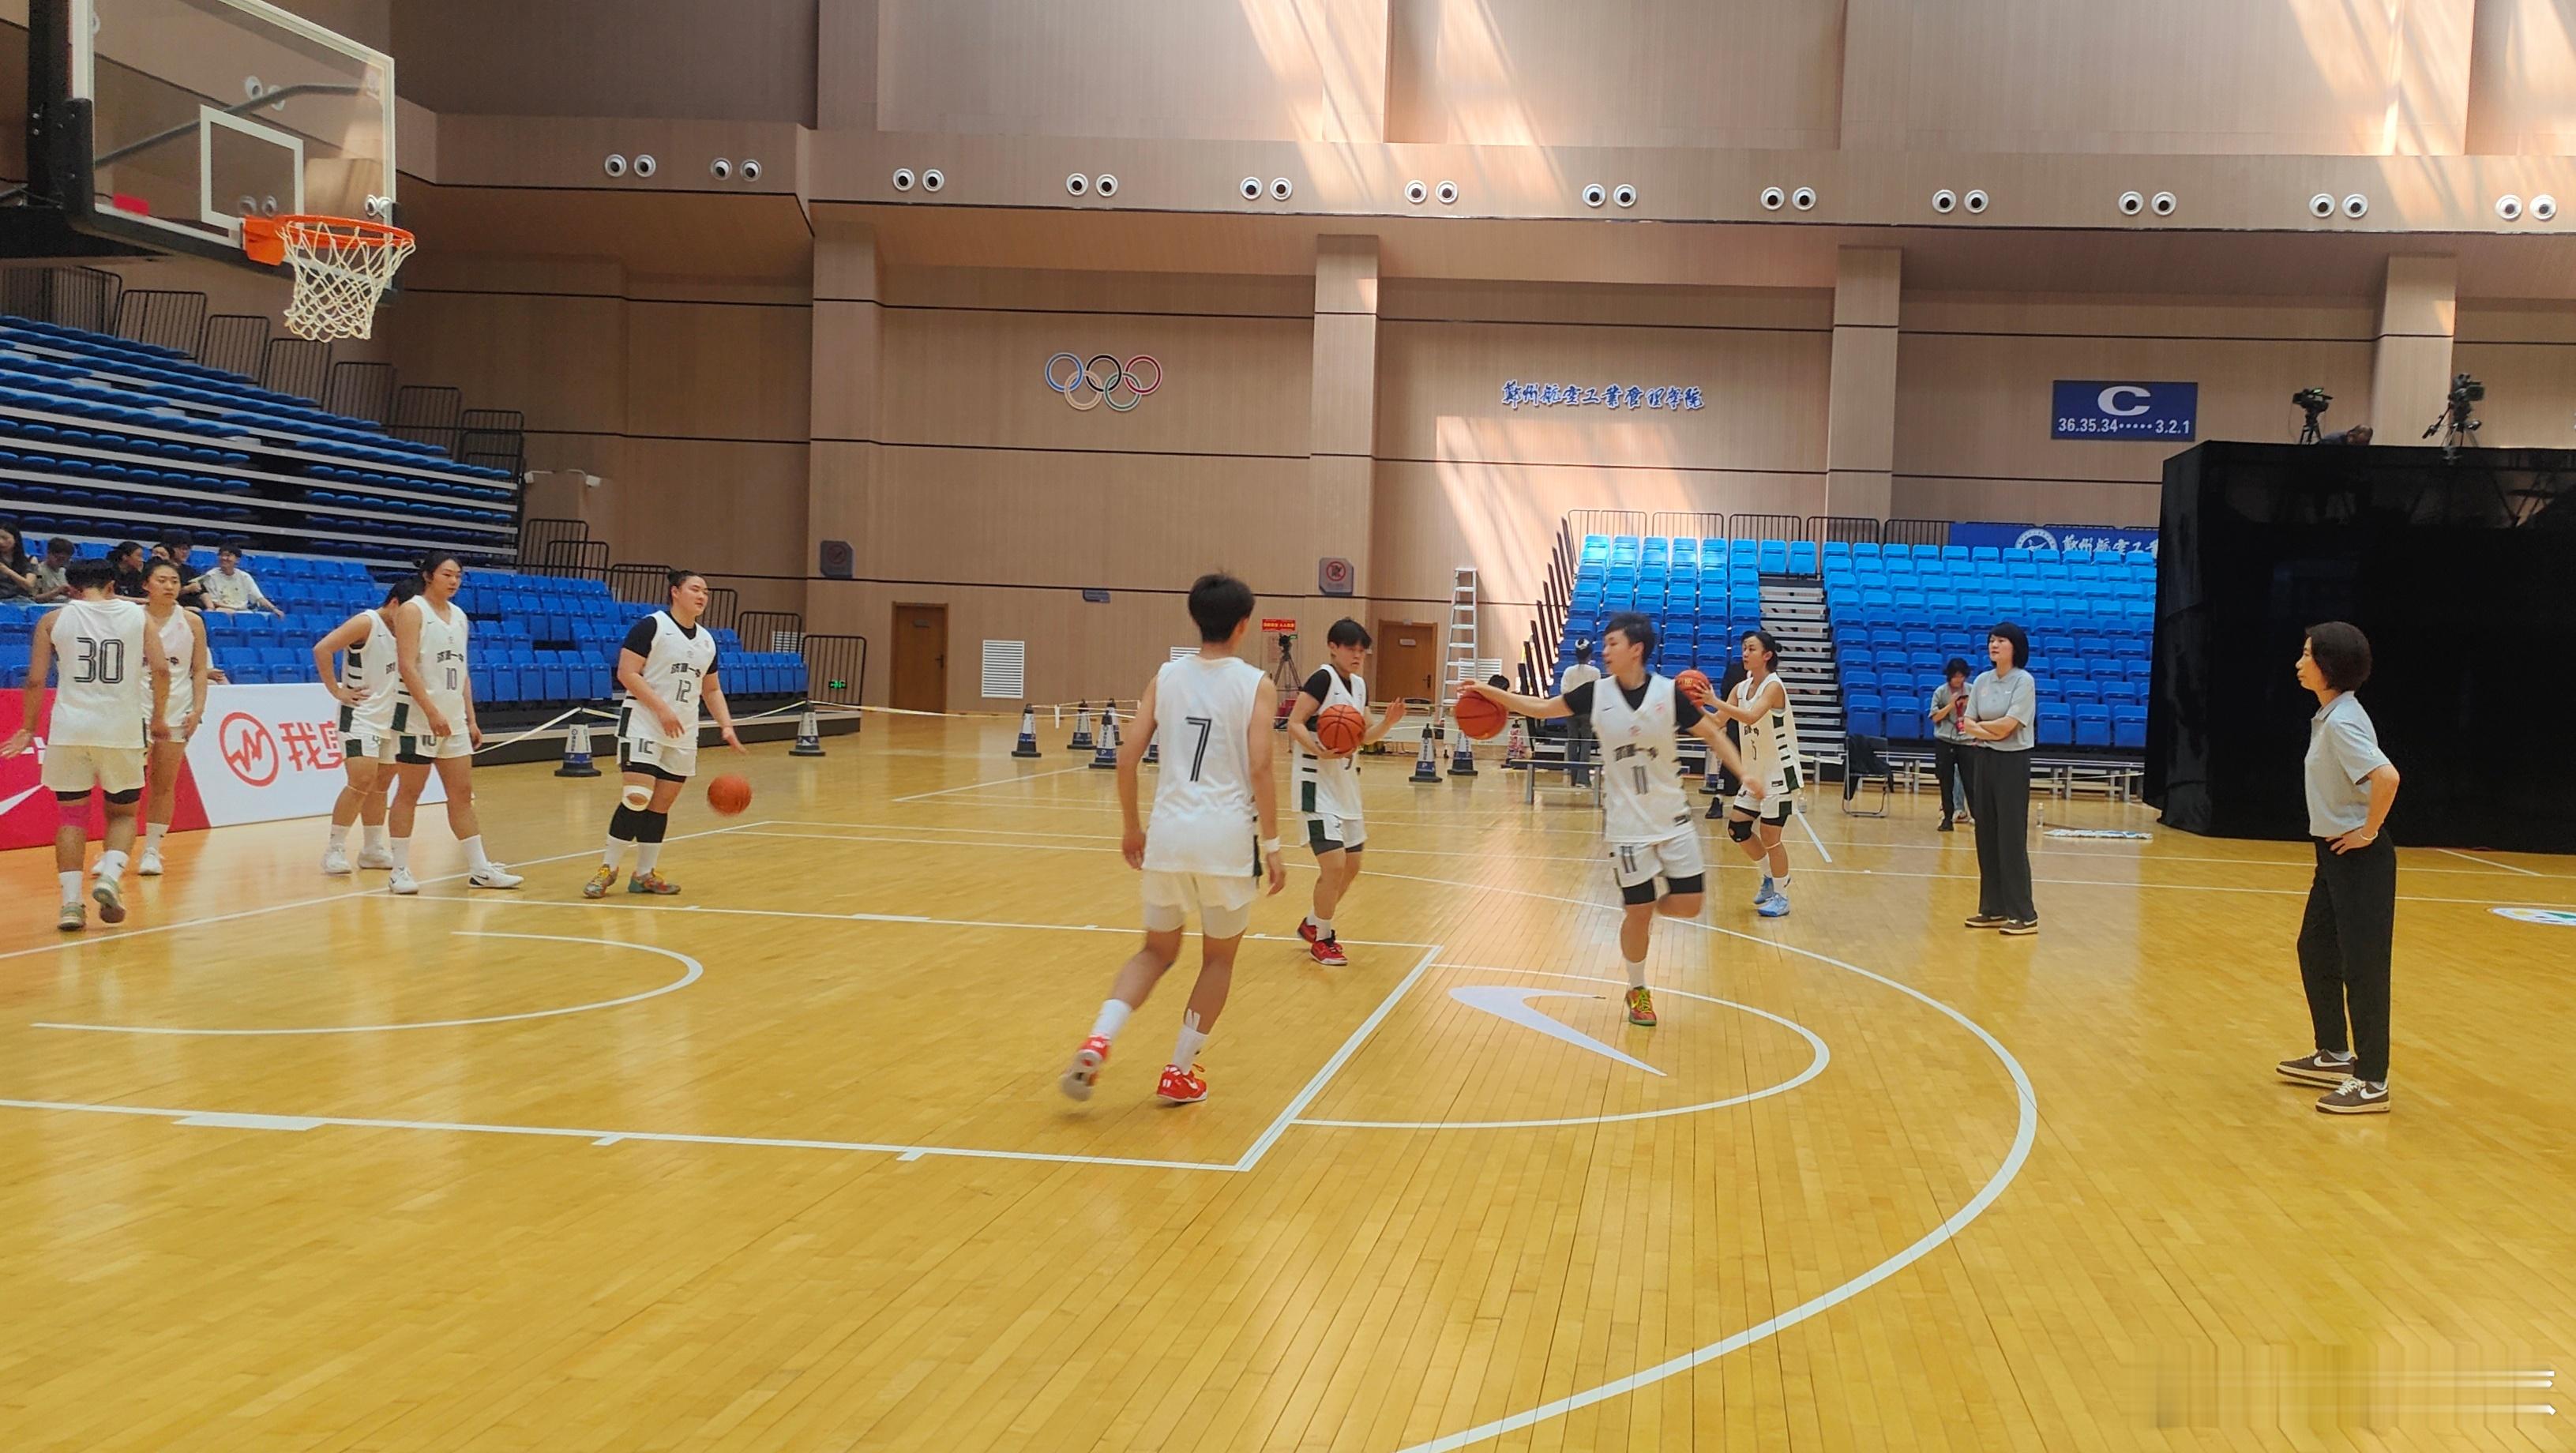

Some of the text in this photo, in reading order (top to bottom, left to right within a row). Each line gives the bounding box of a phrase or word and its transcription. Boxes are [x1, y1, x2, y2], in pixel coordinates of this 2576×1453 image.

[2097, 387, 2151, 416] C
[73, 636, 124, 684] 30
[445, 667, 457, 691] 10
[676, 679, 692, 704] 12
[1185, 716, 1212, 783] 7
[1630, 765, 1650, 795] 11
